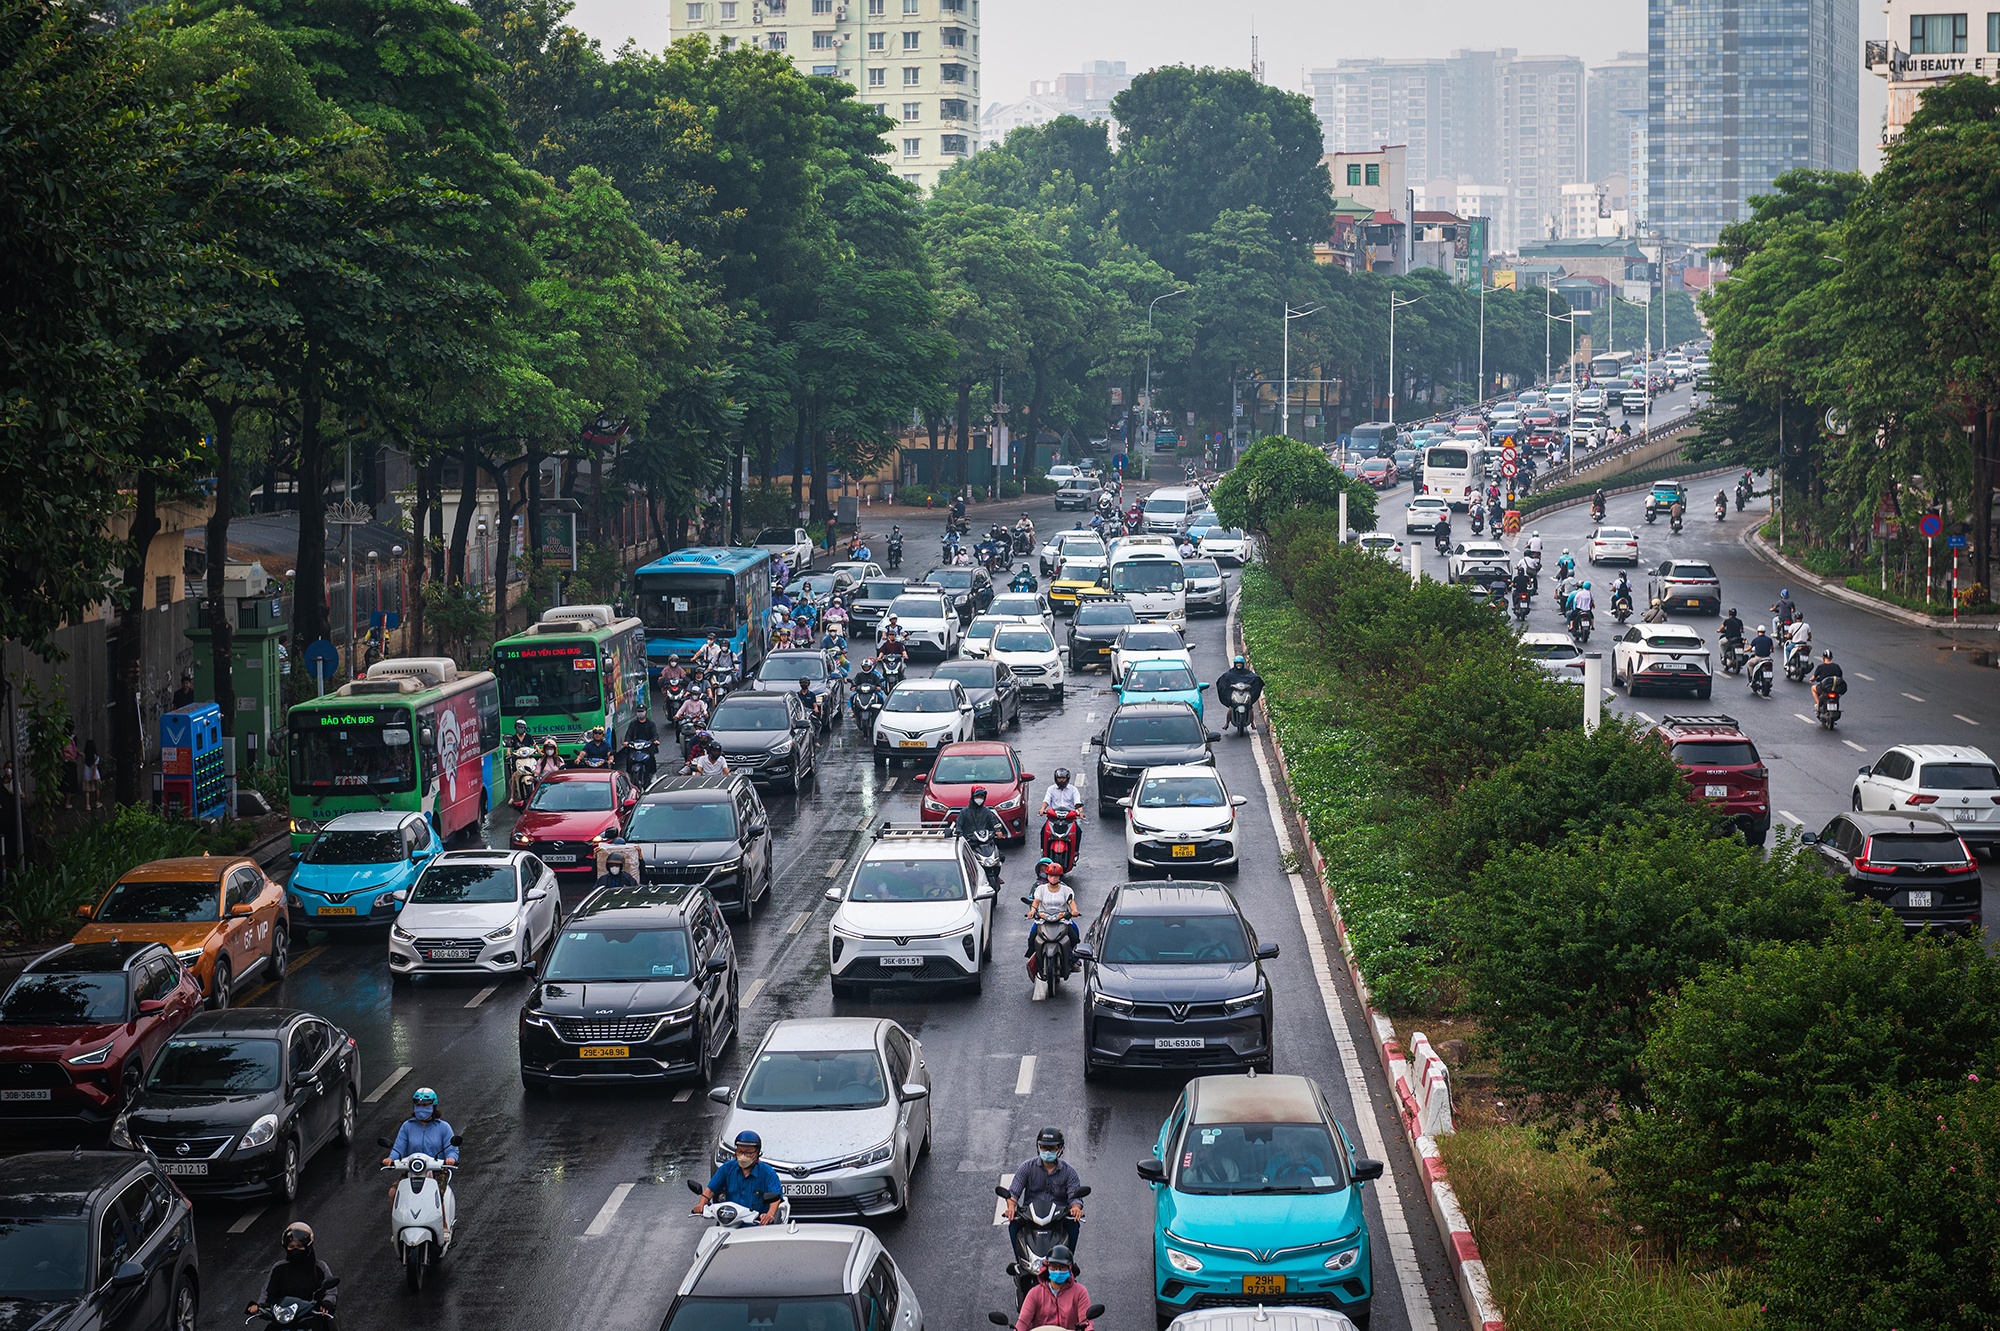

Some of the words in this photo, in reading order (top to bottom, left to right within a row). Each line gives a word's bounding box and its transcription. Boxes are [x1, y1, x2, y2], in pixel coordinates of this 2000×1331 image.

[1899, 60, 1917, 71] HUI
[1920, 58, 1965, 71] BEAUTY
[320, 714, 339, 725] BẢO
[358, 715, 375, 724] BUS
[567, 723, 582, 731] BUS
[312, 808, 332, 818] BẢO
[1910, 899, 1931, 907] 110.15
[256, 920, 269, 941] VIP
[883, 957, 920, 965] 36K-851.51
[1158, 1039, 1201, 1048] 30L-693.06
[583, 1048, 625, 1057] 29E-348.96
[781, 1184, 826, 1195] 0F-300.89
[1255, 1276, 1274, 1285] 29H
[1247, 1285, 1281, 1294] 973.58
